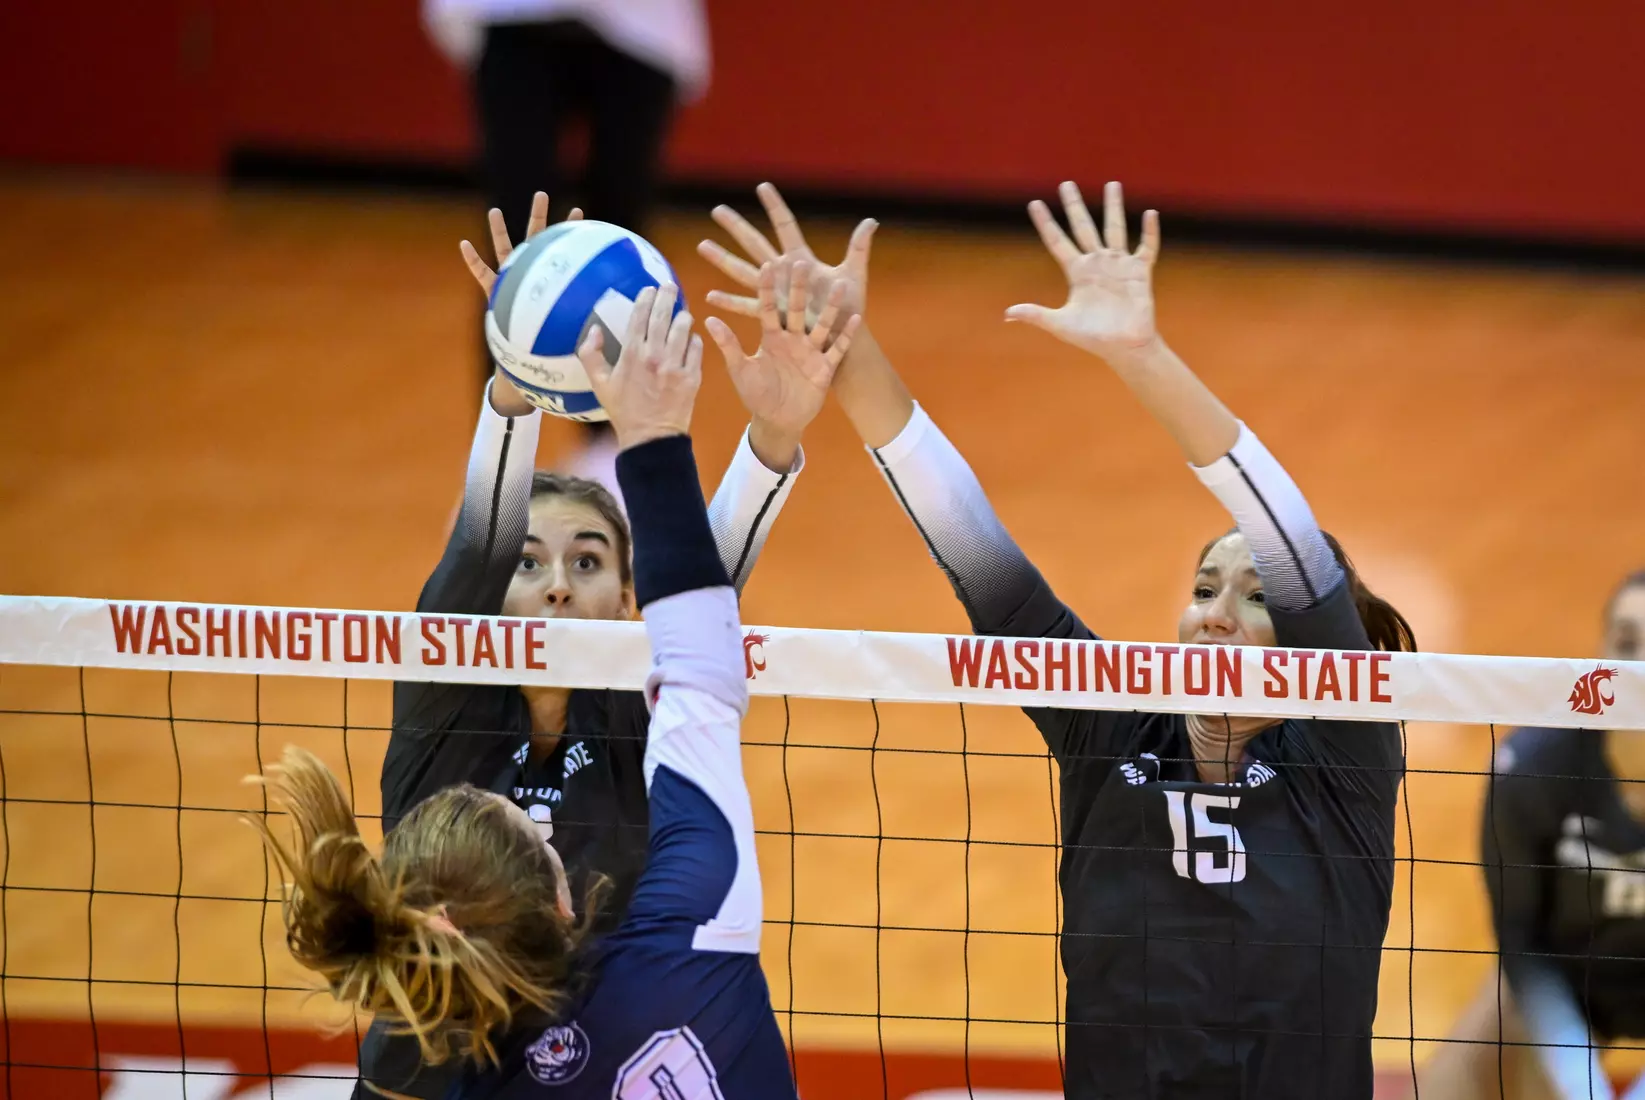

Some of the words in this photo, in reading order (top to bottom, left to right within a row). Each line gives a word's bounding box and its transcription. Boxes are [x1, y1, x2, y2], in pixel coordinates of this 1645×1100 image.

[109, 604, 402, 665] WASHINGTON
[420, 616, 547, 669] STATE
[946, 637, 1243, 698] WASHINGTON
[1263, 649, 1392, 703] STATE
[1163, 790, 1247, 884] 15
